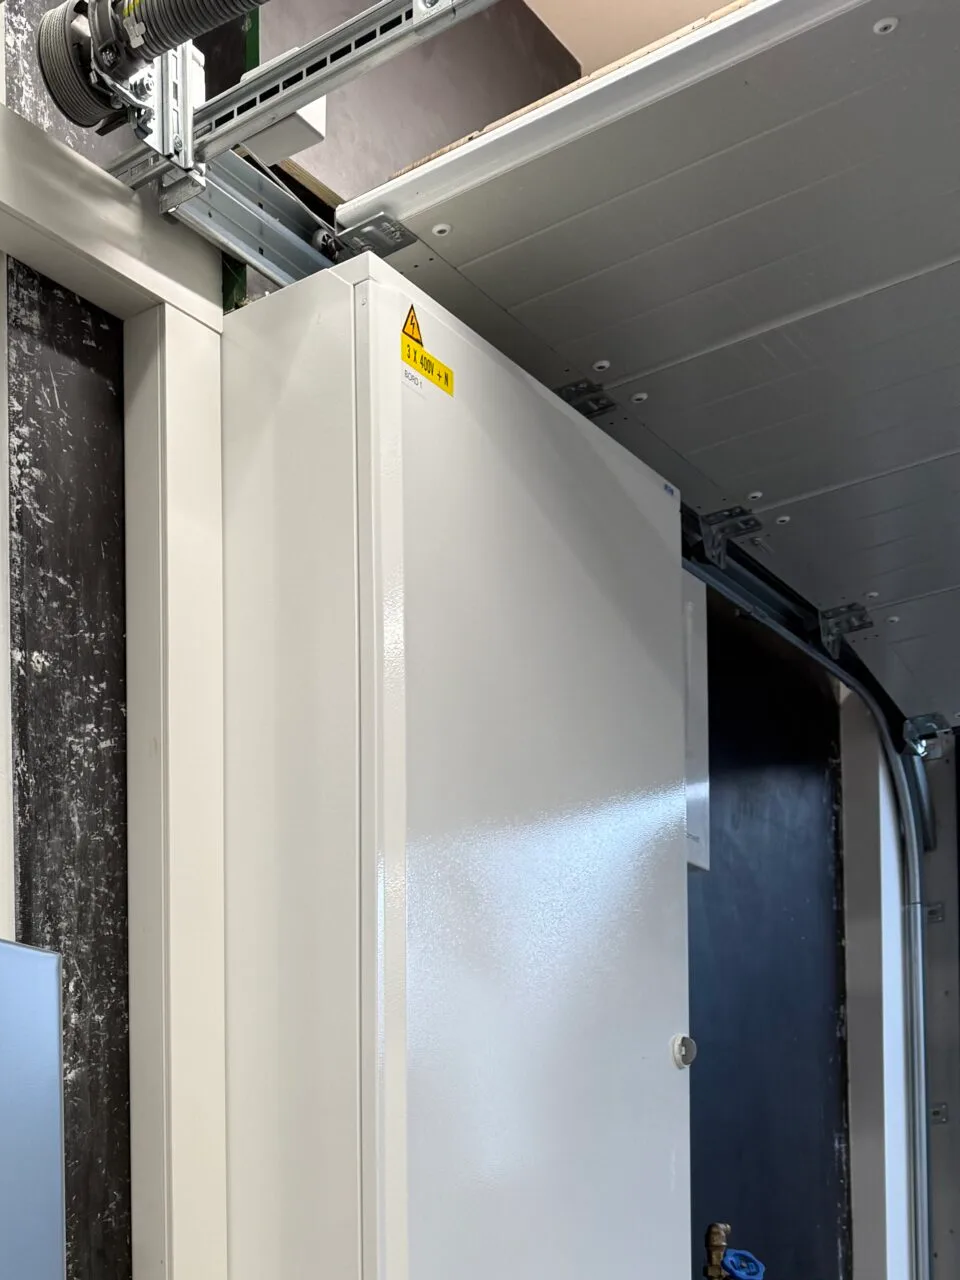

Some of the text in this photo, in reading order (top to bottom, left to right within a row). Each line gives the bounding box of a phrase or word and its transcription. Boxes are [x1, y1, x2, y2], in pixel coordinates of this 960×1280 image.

[406, 344, 411, 359] 3
[420, 354, 435, 376] 400V
[444, 372, 449, 387] N
